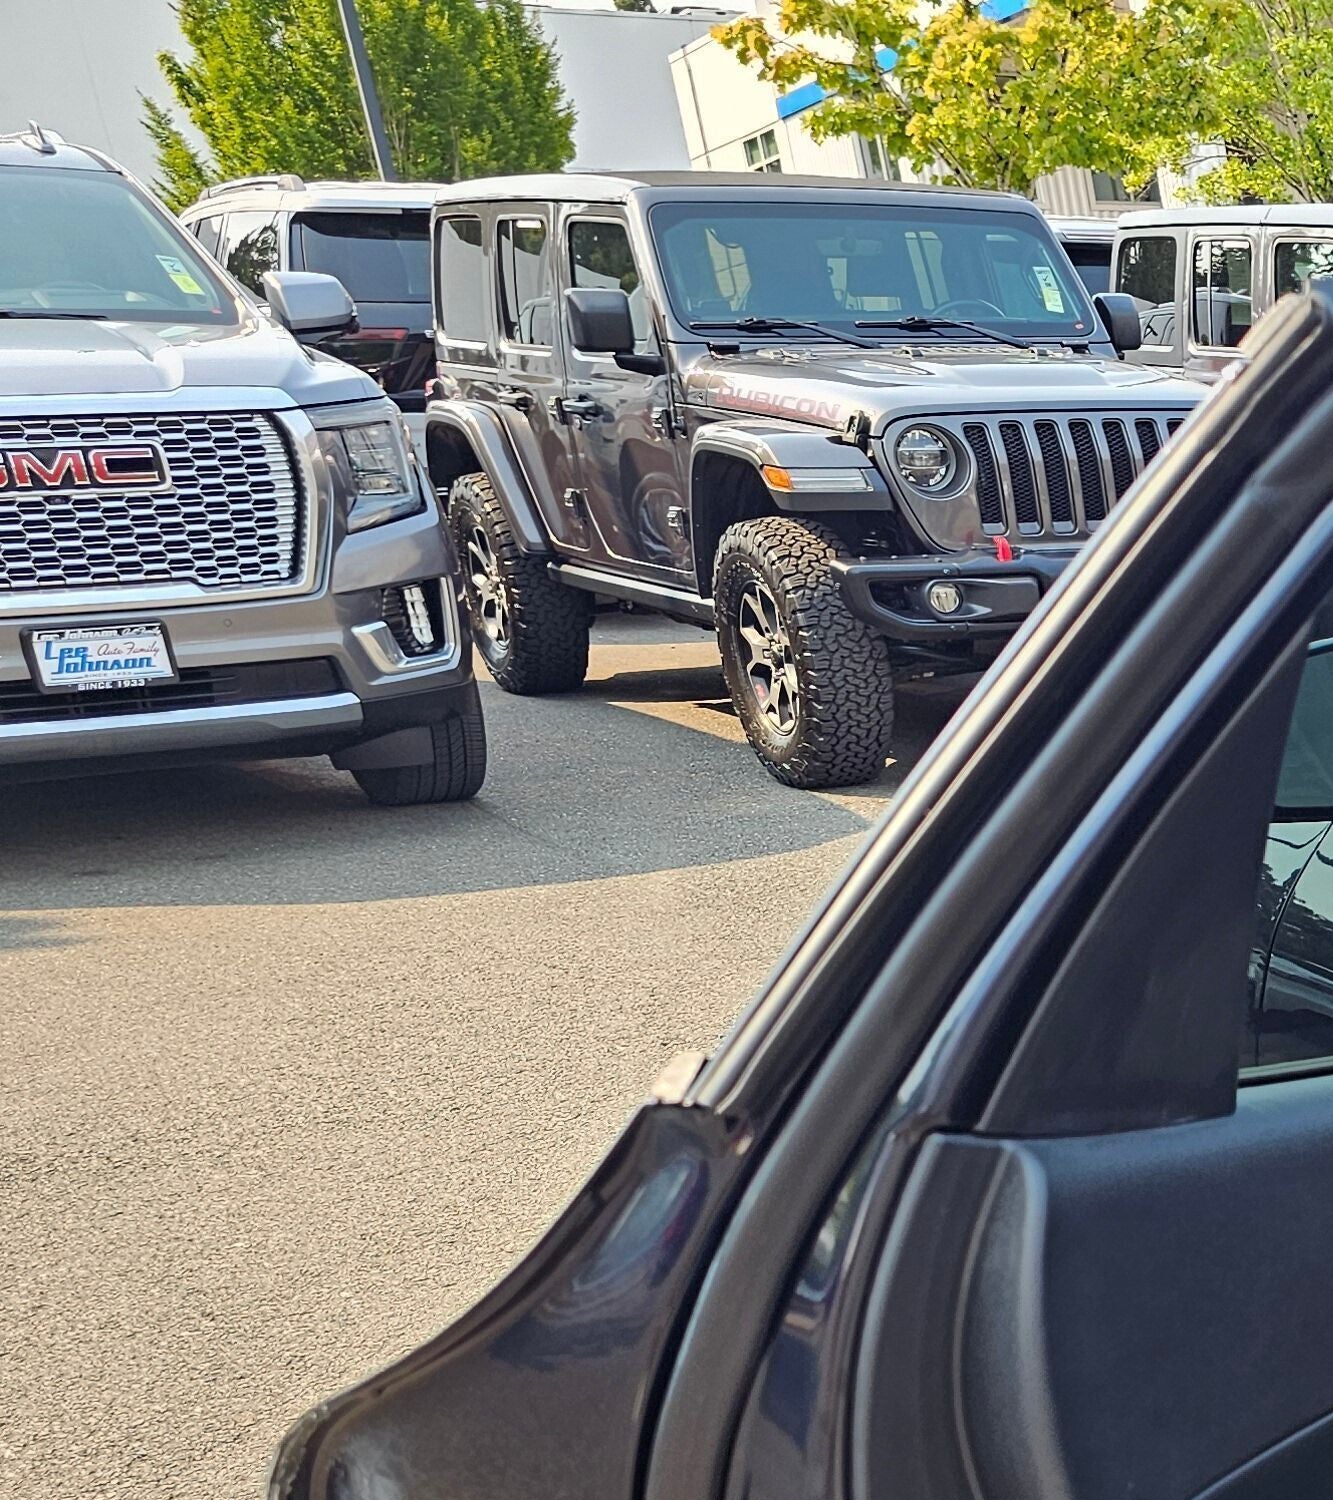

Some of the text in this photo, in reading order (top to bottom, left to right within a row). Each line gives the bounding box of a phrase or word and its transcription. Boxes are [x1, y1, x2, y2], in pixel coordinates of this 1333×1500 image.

[717, 386, 841, 420] RUBICON
[0, 448, 160, 487] MC
[45, 641, 92, 660] Lee
[124, 641, 160, 657] Family
[51, 652, 157, 675] Johnson
[77, 679, 146, 691] SINCE 1933
